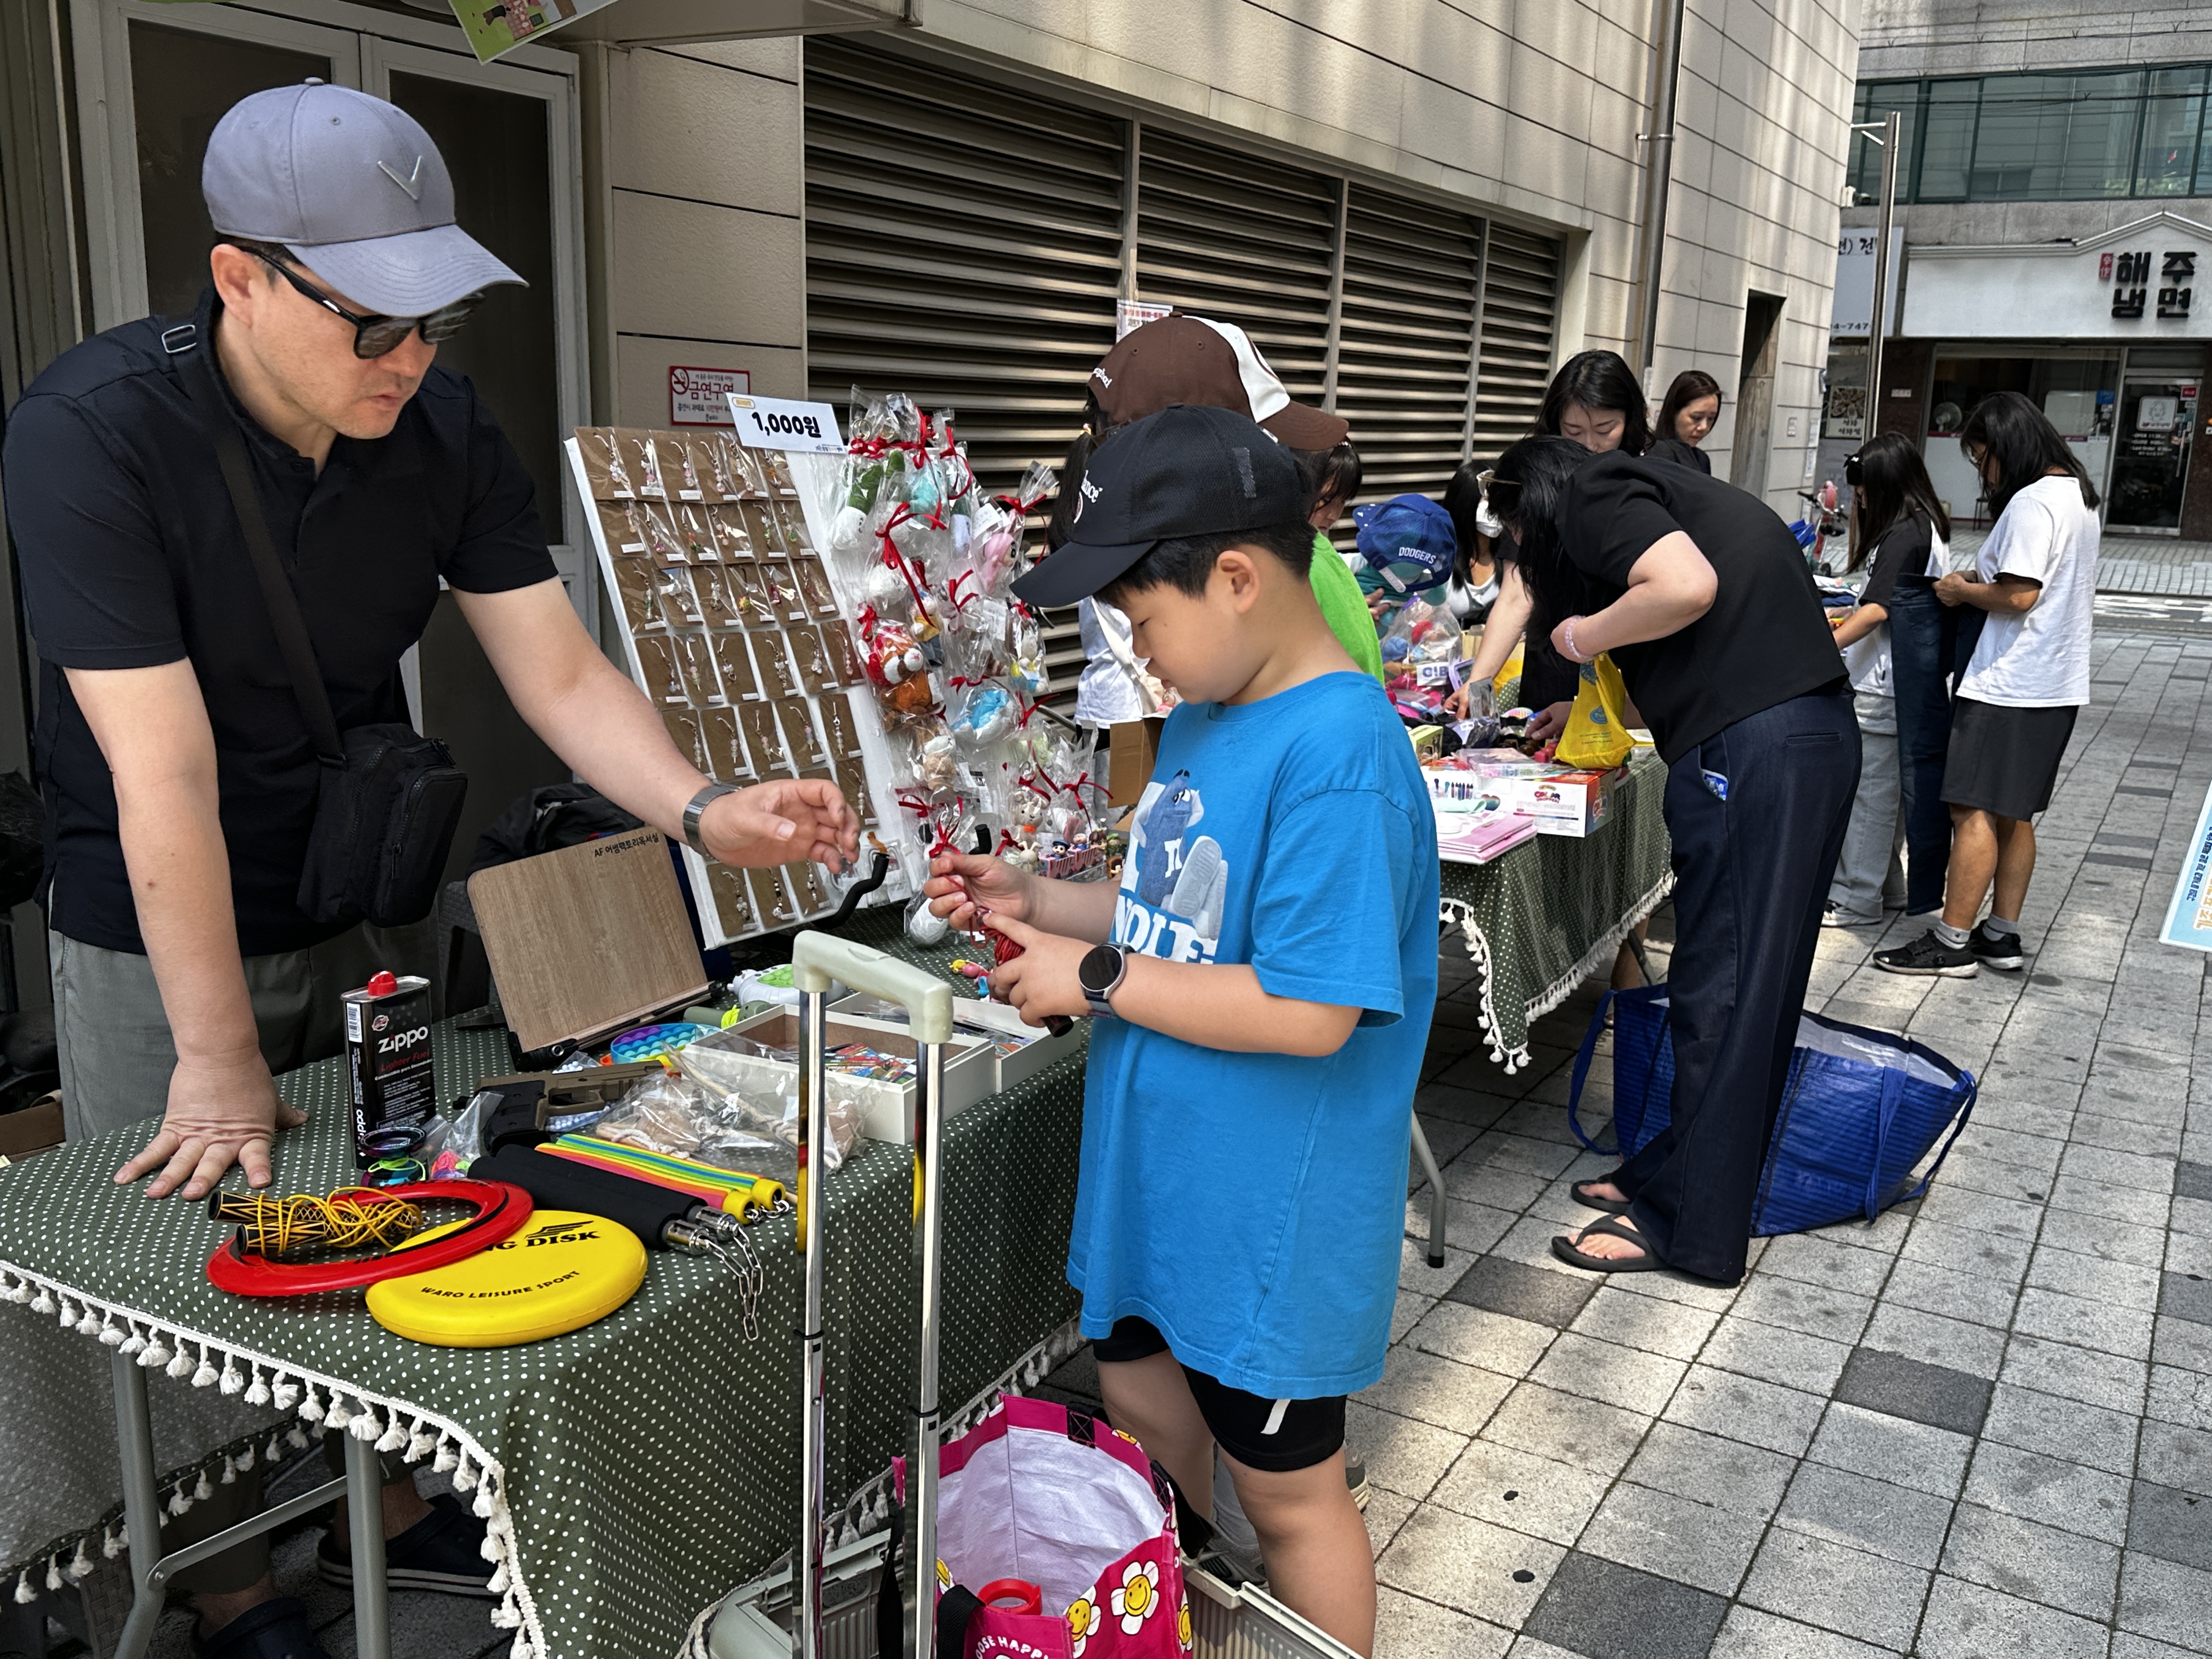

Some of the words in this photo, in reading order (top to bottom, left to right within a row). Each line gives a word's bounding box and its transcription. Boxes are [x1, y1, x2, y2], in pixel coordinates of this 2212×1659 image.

[2116, 252, 2197, 284] 해주
[2111, 287, 2192, 320] 냉면
[689, 381, 734, 401] 금연구역
[751, 411, 822, 438] 1,000원
[1398, 546, 1437, 565] DODGERS
[594, 848, 604, 857] AF
[377, 1026, 428, 1054] zippo
[381, 1057, 411, 1073] Lighter
[412, 1048, 430, 1062] Fuel
[525, 1231, 601, 1247] DISK
[421, 1286, 464, 1297] WARO
[468, 1286, 533, 1299] LEISURE
[537, 1270, 580, 1290] SPORT
